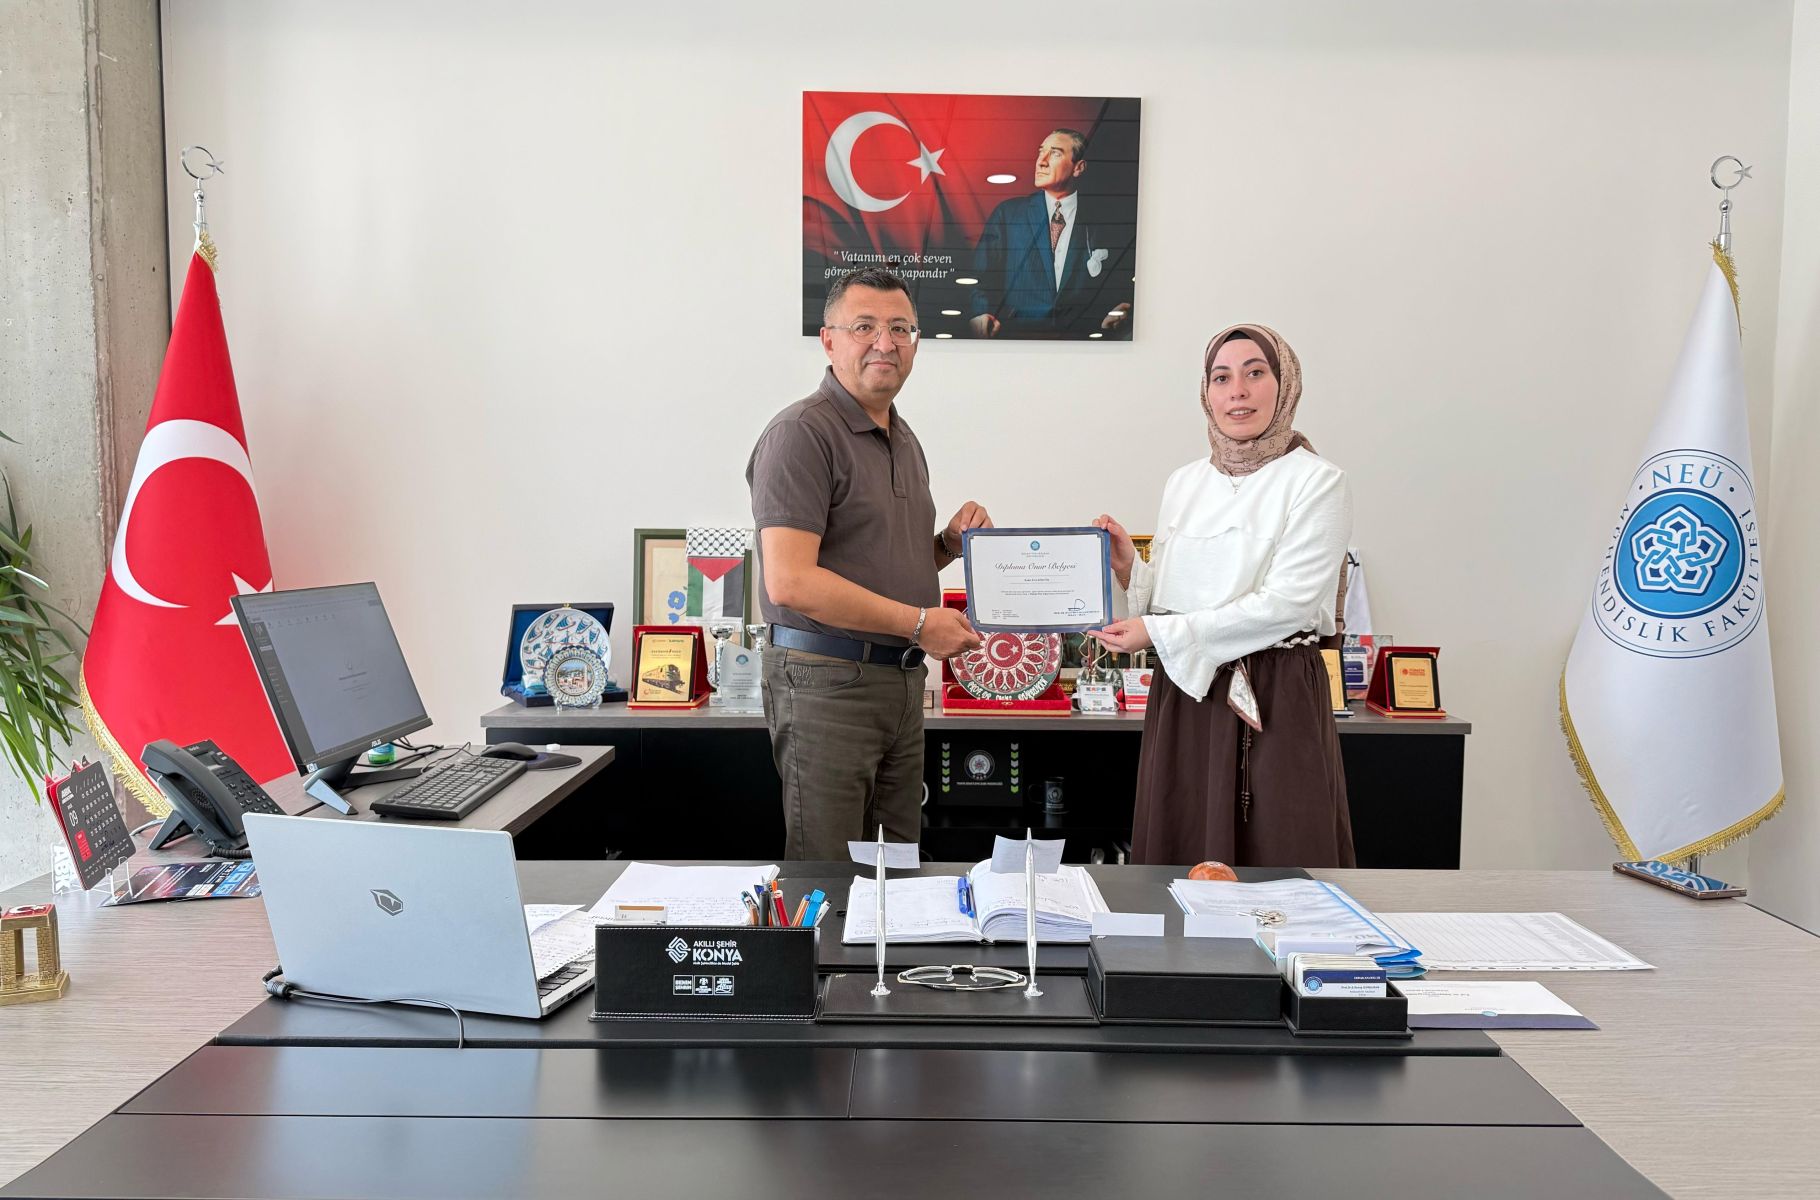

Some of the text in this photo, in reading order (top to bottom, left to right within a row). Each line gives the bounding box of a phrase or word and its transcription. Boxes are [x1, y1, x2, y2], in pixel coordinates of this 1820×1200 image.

[841, 251, 886, 262] Vatanını
[888, 254, 900, 262] en
[903, 253, 921, 265] çok
[923, 254, 952, 264] seven
[901, 267, 948, 280] yapandır
[1652, 463, 1724, 488] NEÜ
[1703, 508, 1760, 638] FAKÜLTESİ
[716, 940, 737, 949] ŞEHİR
[692, 948, 743, 962] KONYA
